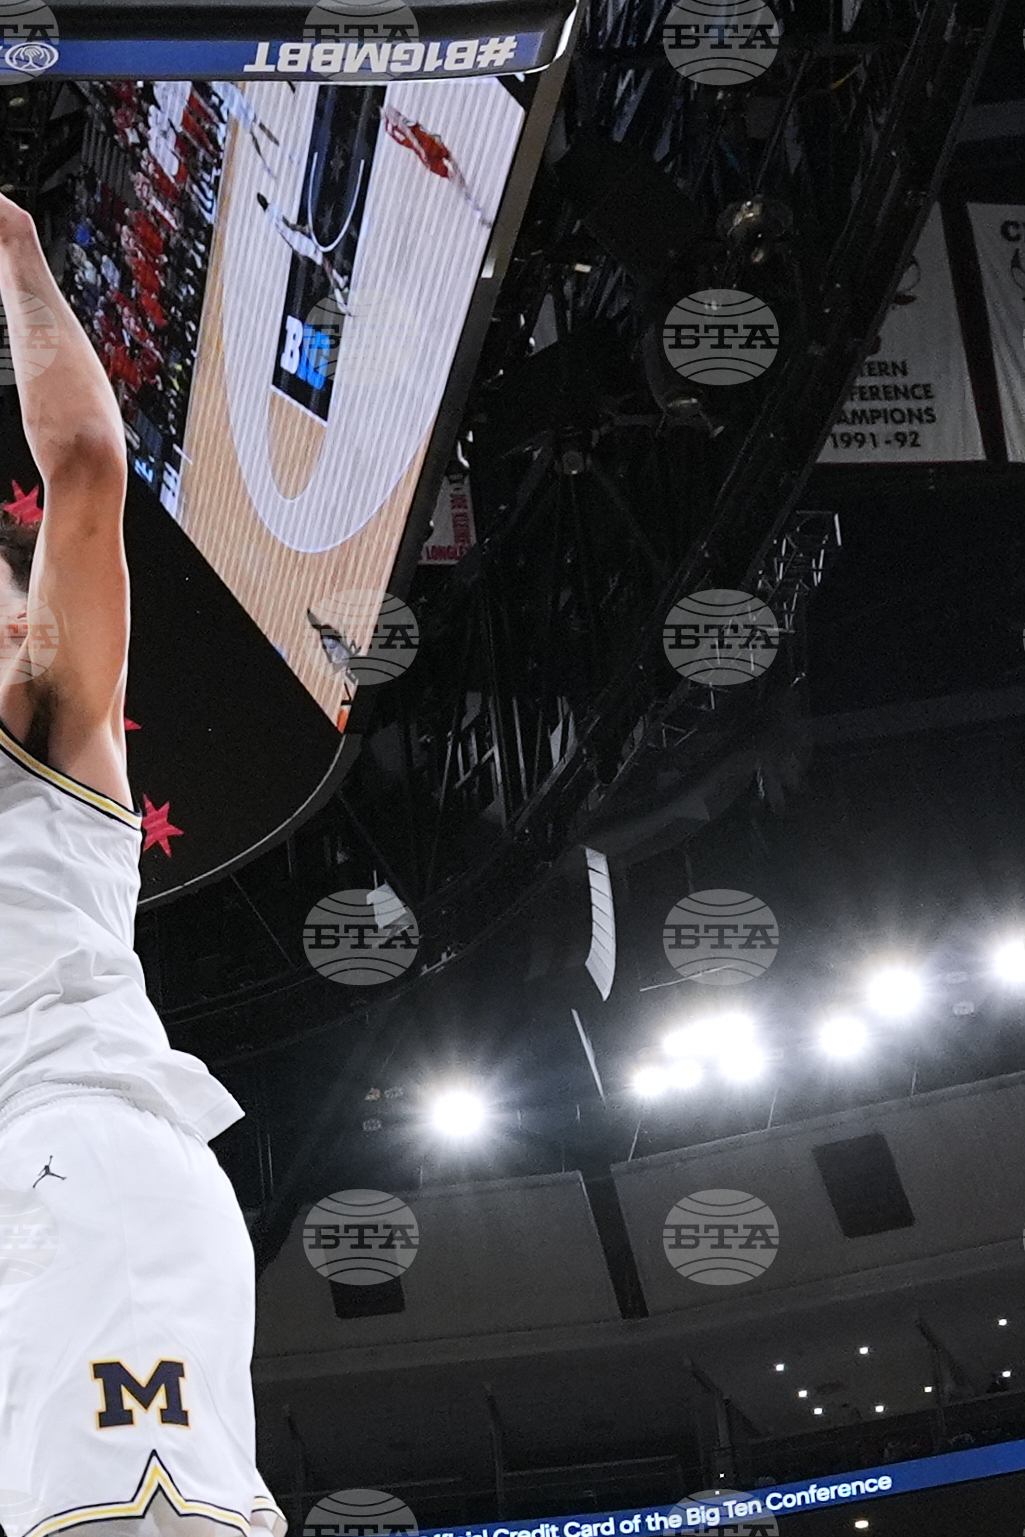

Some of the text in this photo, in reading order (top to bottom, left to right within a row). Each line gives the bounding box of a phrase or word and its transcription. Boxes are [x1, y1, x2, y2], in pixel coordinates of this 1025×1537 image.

[244, 37, 518, 74] #B1GMBBT
[849, 384, 934, 400] FERENCE
[838, 407, 936, 424] AMPIONS
[92, 1360, 190, 1430] M
[619, 1514, 642, 1533] of
[644, 1511, 682, 1531] the
[685, 1505, 721, 1528] Big
[722, 1499, 763, 1519] Ten
[764, 1474, 893, 1512] Conference
